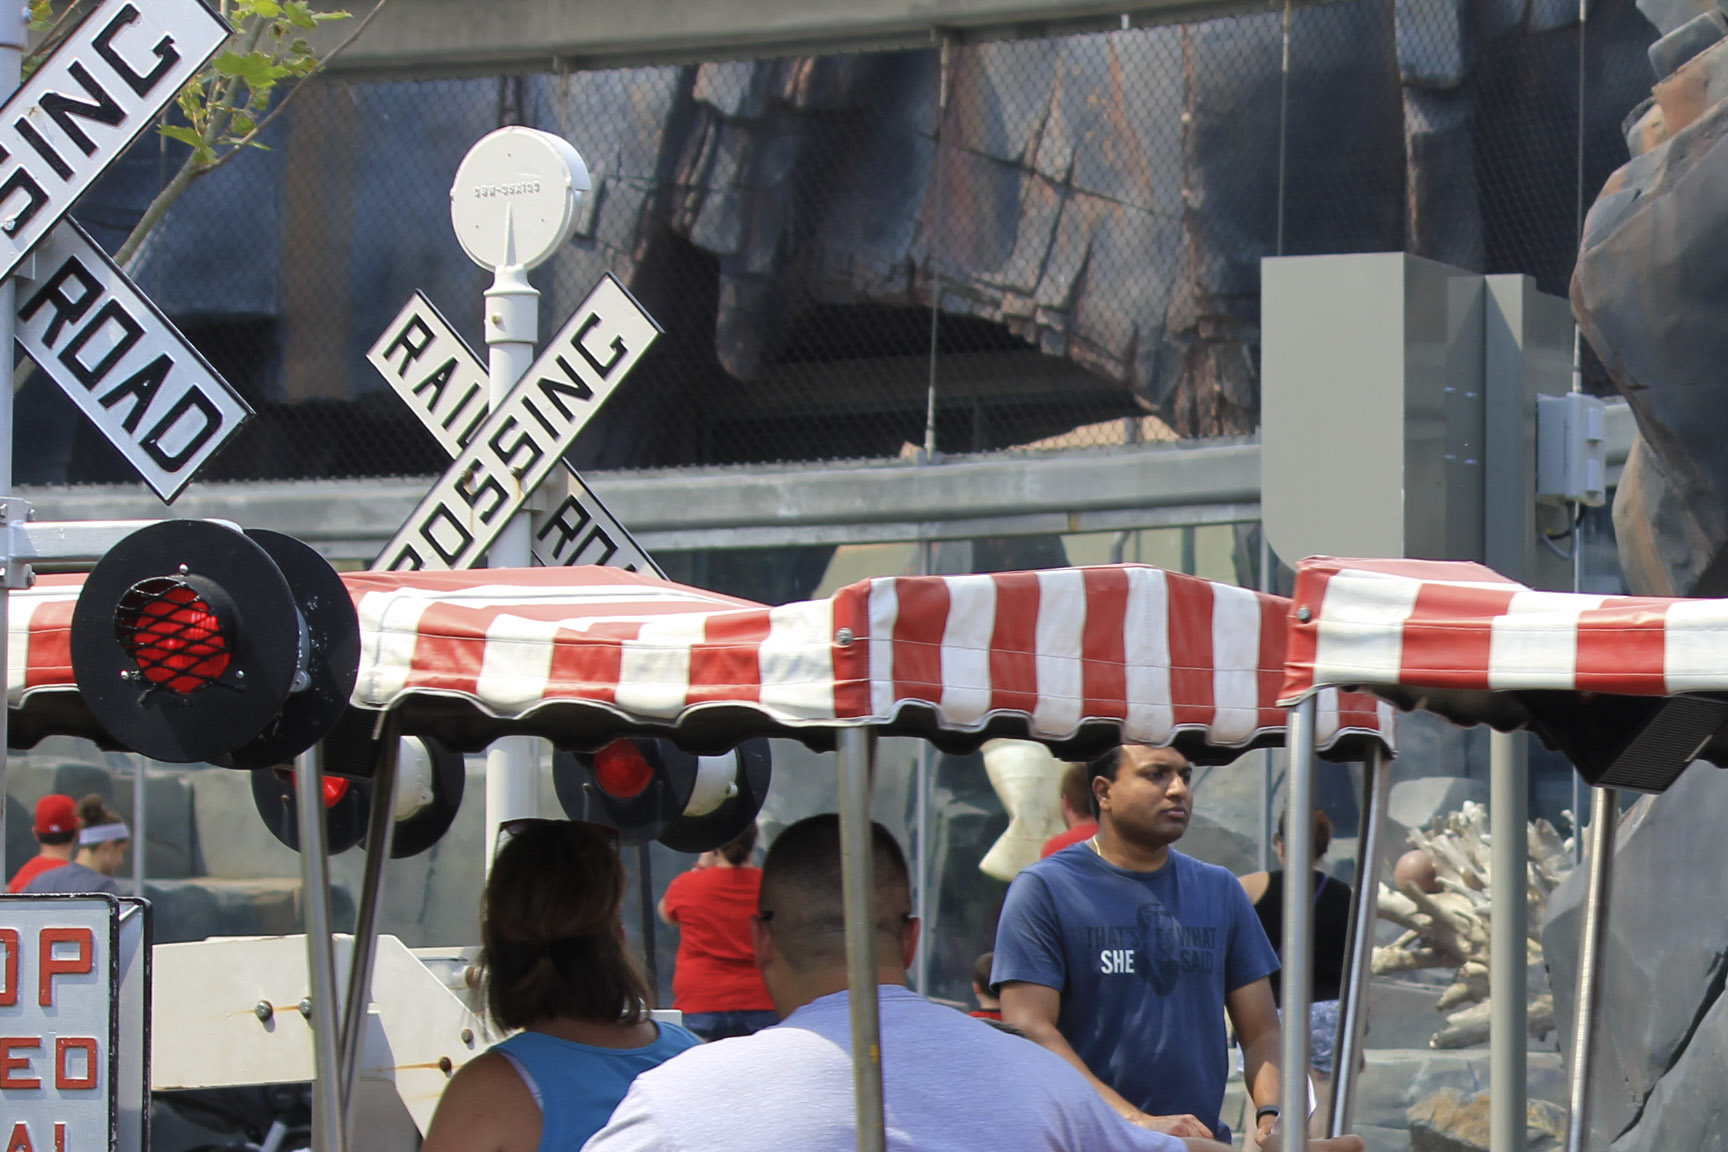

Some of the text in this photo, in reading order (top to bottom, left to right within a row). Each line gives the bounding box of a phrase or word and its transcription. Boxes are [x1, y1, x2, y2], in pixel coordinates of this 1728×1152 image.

[17, 255, 224, 474] ROAD
[1178, 926, 1217, 950] WHAT
[1100, 949, 1214, 974] SHE SAID
